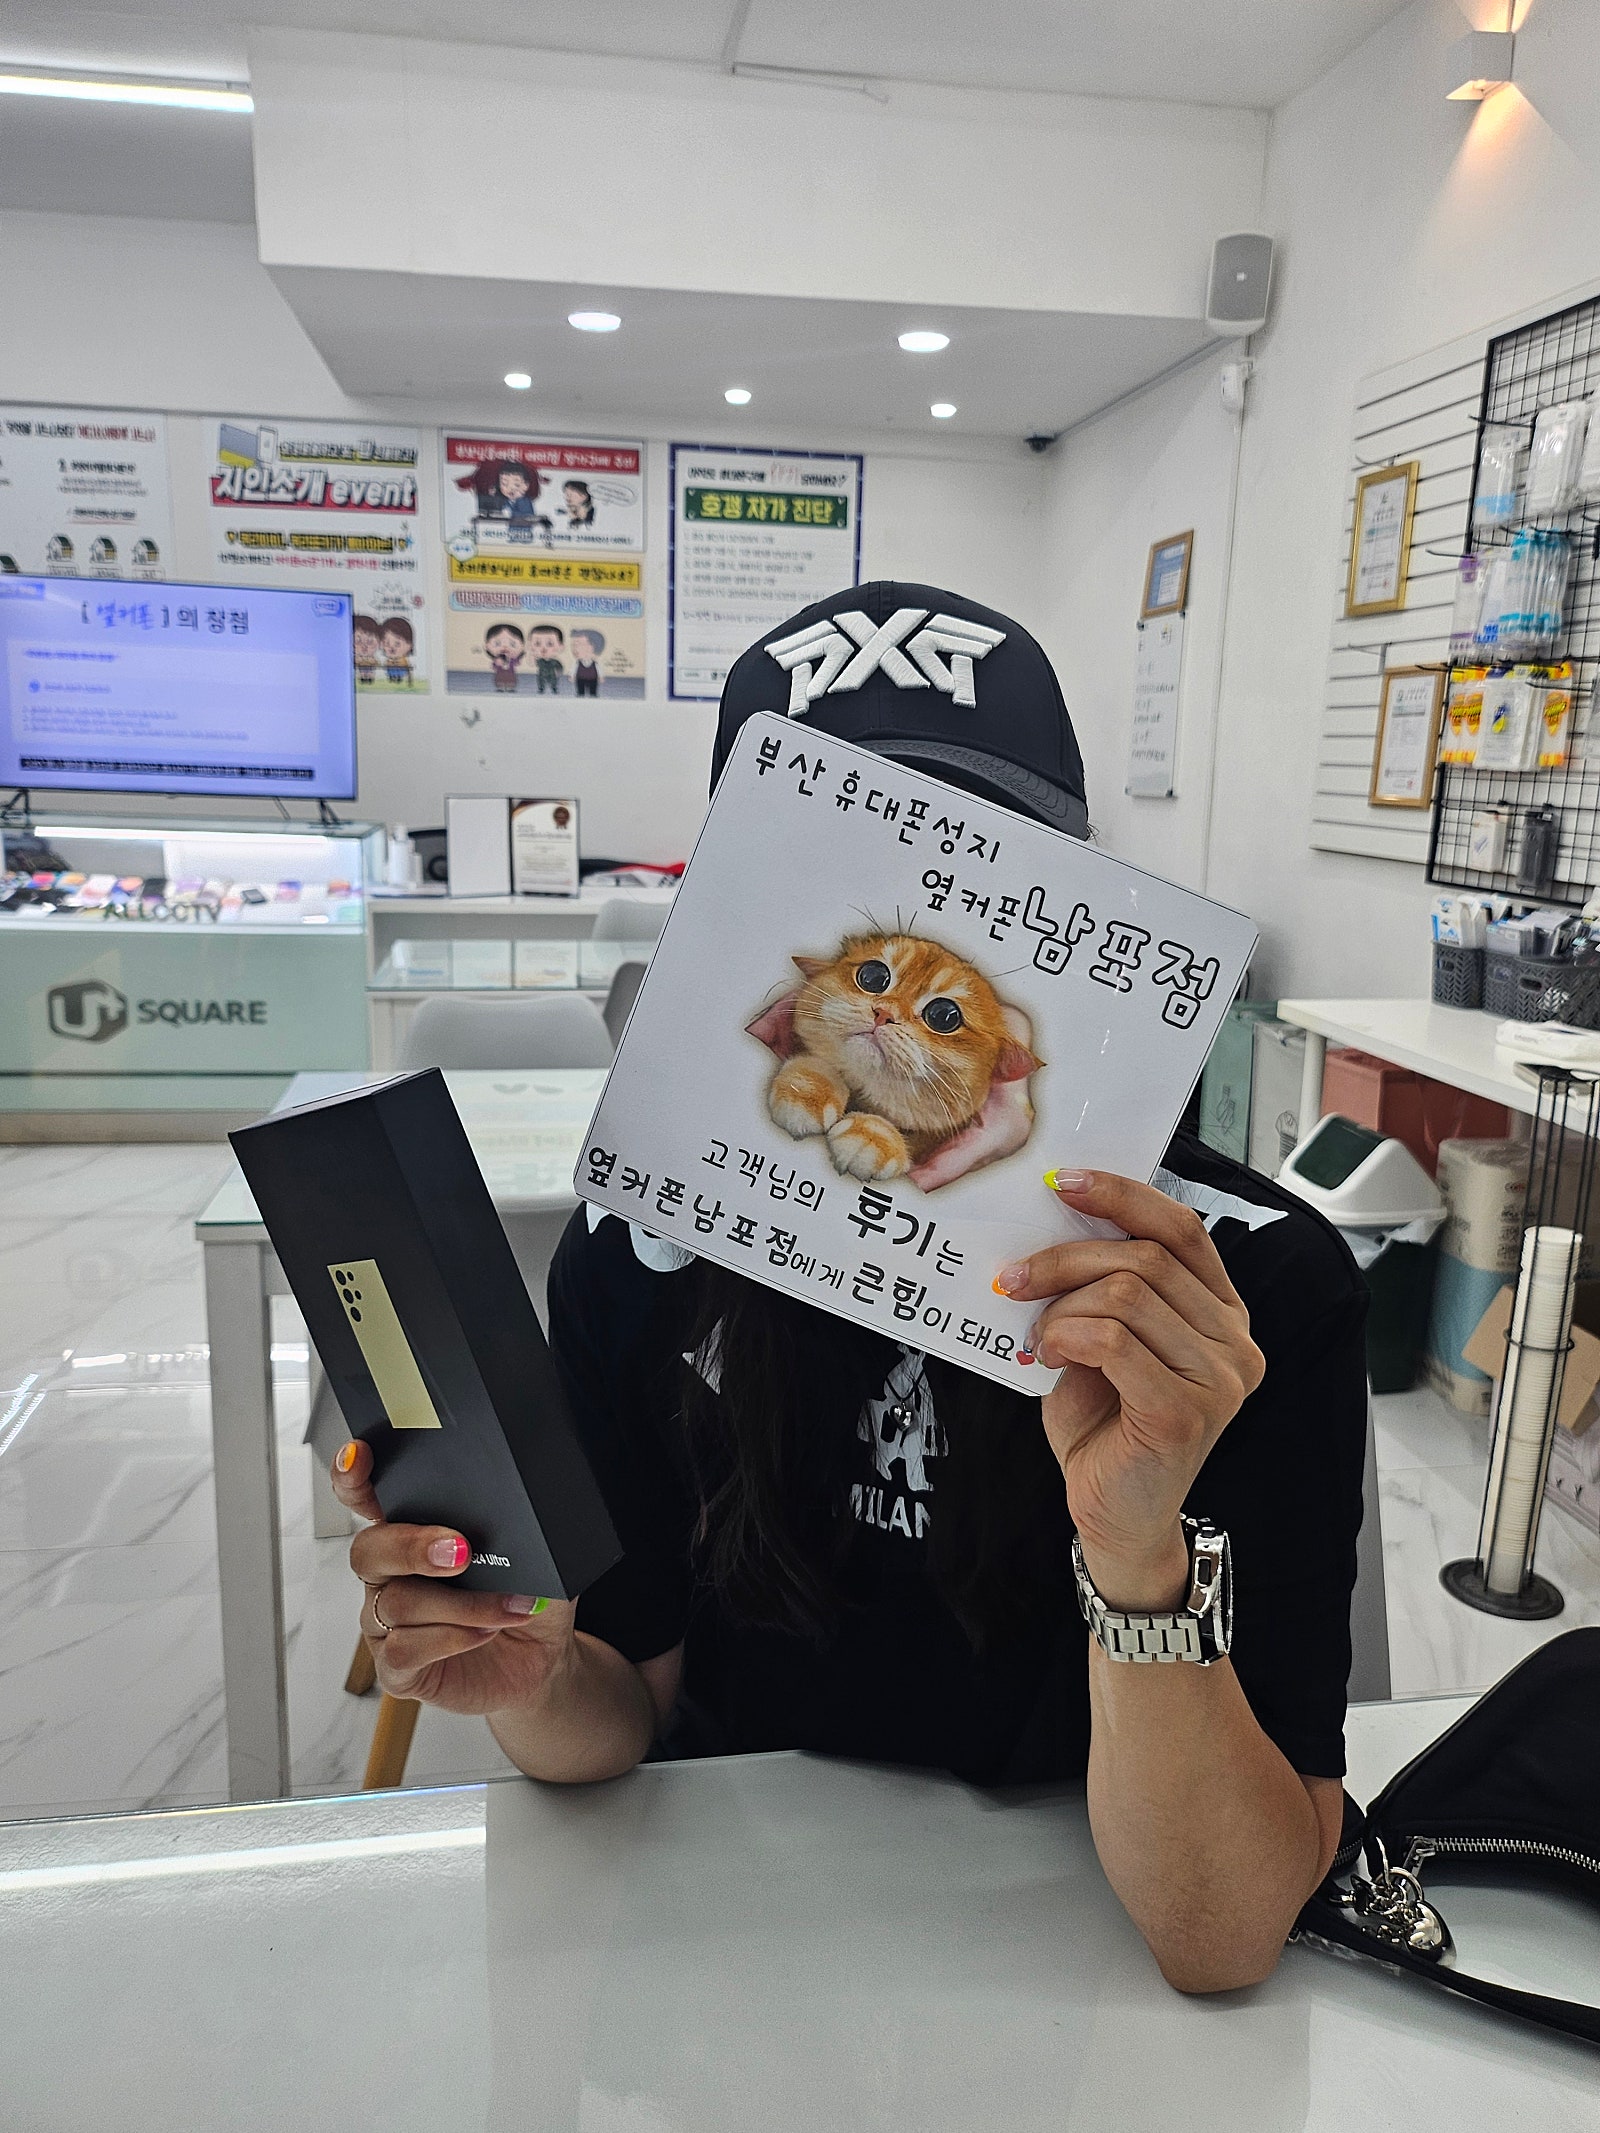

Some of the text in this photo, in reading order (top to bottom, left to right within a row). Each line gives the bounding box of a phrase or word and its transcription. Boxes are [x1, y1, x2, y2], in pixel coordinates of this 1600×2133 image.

[216, 466, 414, 508] 지인소개 event
[746, 497, 788, 522] 자가
[791, 499, 834, 525] 진단
[763, 608, 1007, 718] PXG
[756, 737, 1001, 863] 부산 휴대폰성지
[137, 1000, 268, 1025] SQUARE
[701, 1138, 964, 1277] 고객님의 후기는
[587, 1147, 845, 1290] 옆커폰남포점에게
[956, 1317, 1015, 1362] 돼요
[485, 1554, 511, 1567] Ultra
